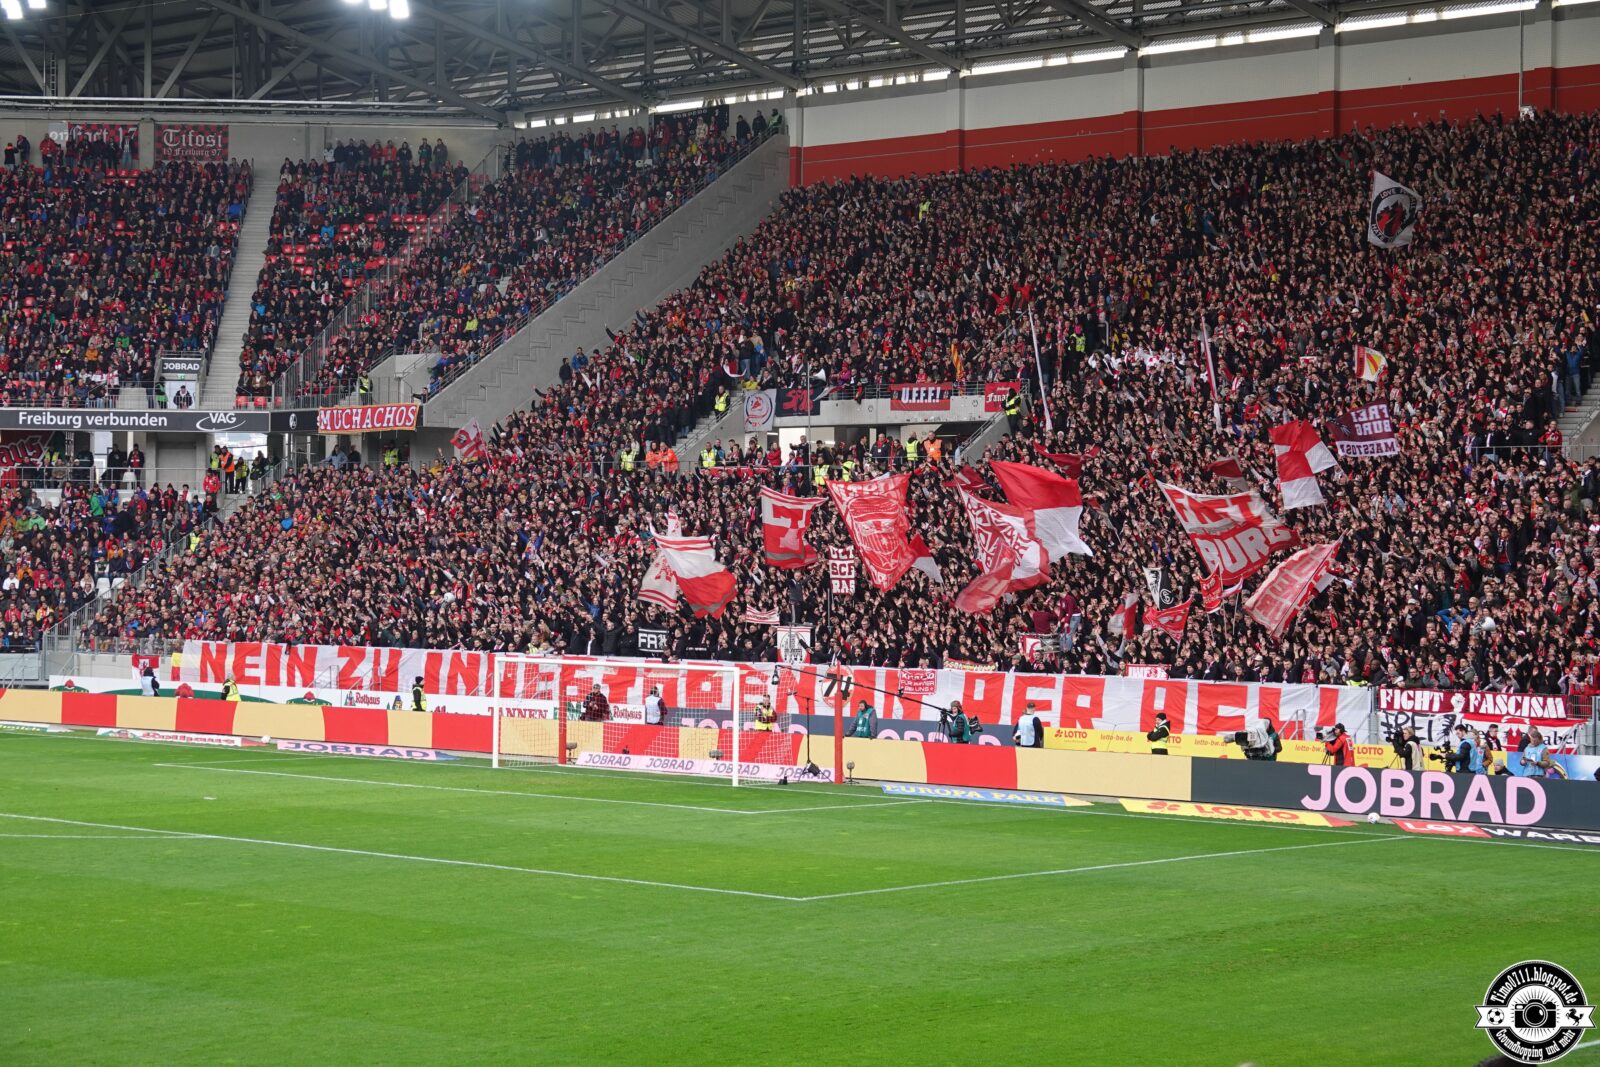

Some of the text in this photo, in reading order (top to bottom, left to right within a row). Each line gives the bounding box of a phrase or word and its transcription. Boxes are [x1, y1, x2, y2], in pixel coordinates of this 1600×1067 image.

[163, 128, 223, 147] Tifosi
[162, 362, 200, 371] JOBRAD
[18, 411, 168, 428] Freiburg verbunden
[209, 412, 237, 424] VAG
[320, 406, 416, 430] MUCHACHOS
[1196, 526, 1292, 575] BURG
[831, 562, 853, 576] SCF
[200, 642, 318, 688] NEIN
[337, 645, 403, 692] ZU
[962, 672, 1106, 731] DER
[355, 692, 381, 706] Rothaus
[1380, 688, 1567, 719] FIGHT FASCISM
[613, 705, 642, 720] Rothaus
[1064, 731, 1088, 739] LOTTO
[1101, 733, 1133, 742] lotto-bw.de
[284, 741, 430, 760] JOBRAD
[1357, 746, 1384, 756] LOTTO
[584, 753, 632, 767] JOBRAD
[645, 760, 695, 771] JOBRAD
[884, 784, 1059, 804] EUROPA PARK
[1300, 764, 1548, 826] JOBRAD
[1194, 804, 1300, 820] LOTTO
